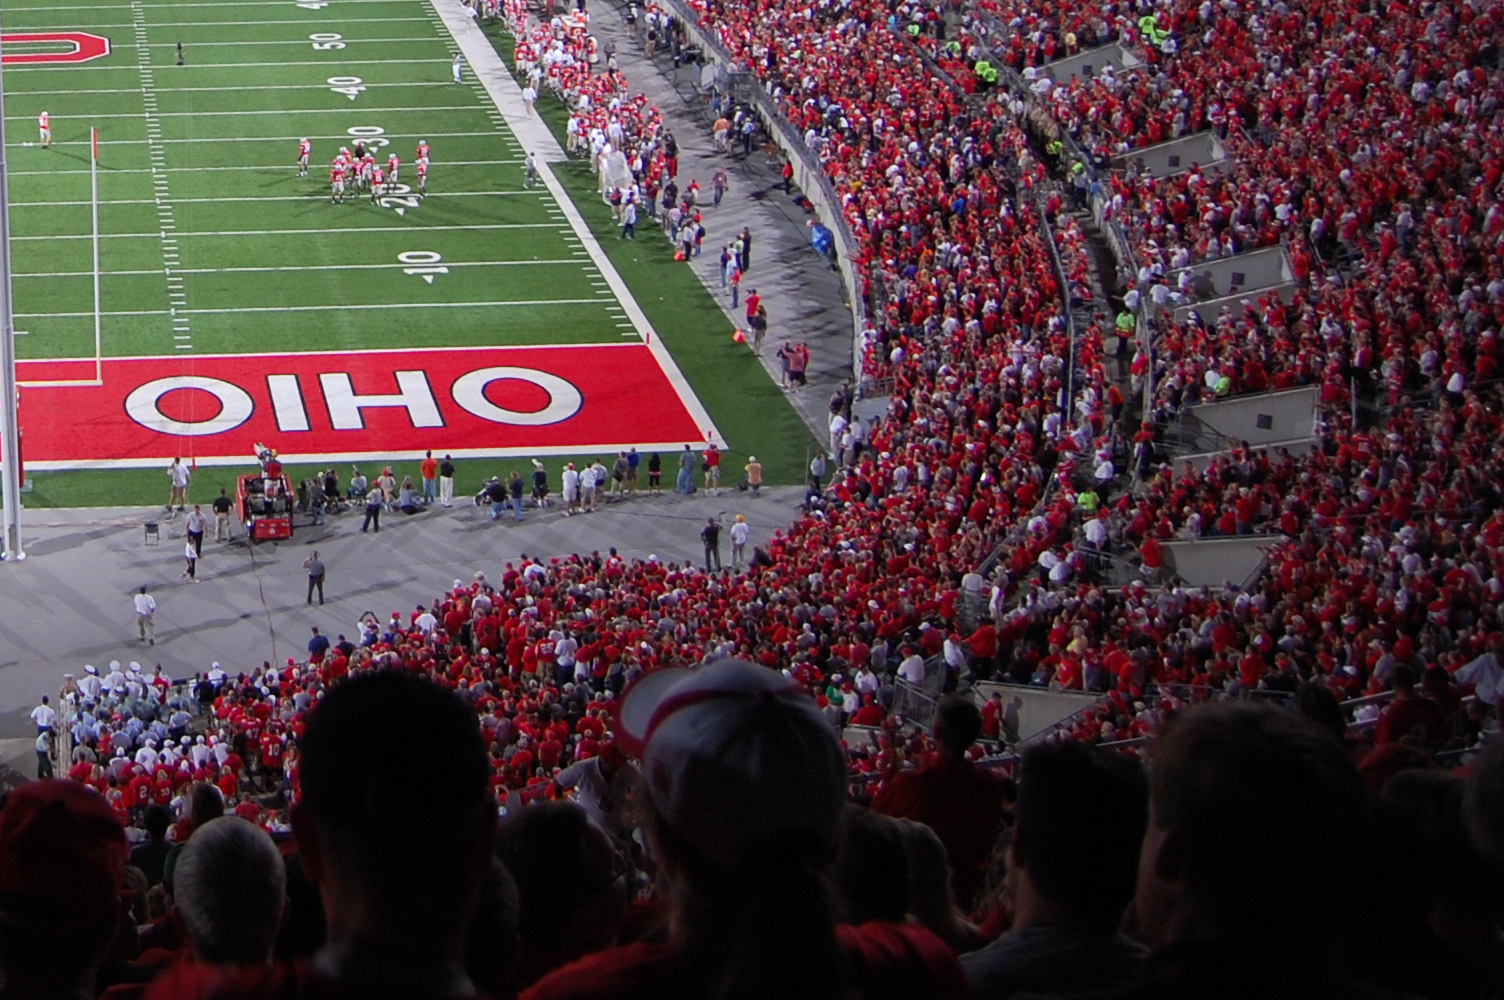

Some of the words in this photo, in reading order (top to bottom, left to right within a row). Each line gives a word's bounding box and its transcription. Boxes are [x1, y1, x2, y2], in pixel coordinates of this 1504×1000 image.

[309, 33, 346, 50] 50
[326, 76, 367, 95] 40
[346, 126, 390, 147] 30
[397, 250, 449, 275] 10
[123, 365, 584, 436] OHIO
[268, 743, 280, 756] 10
